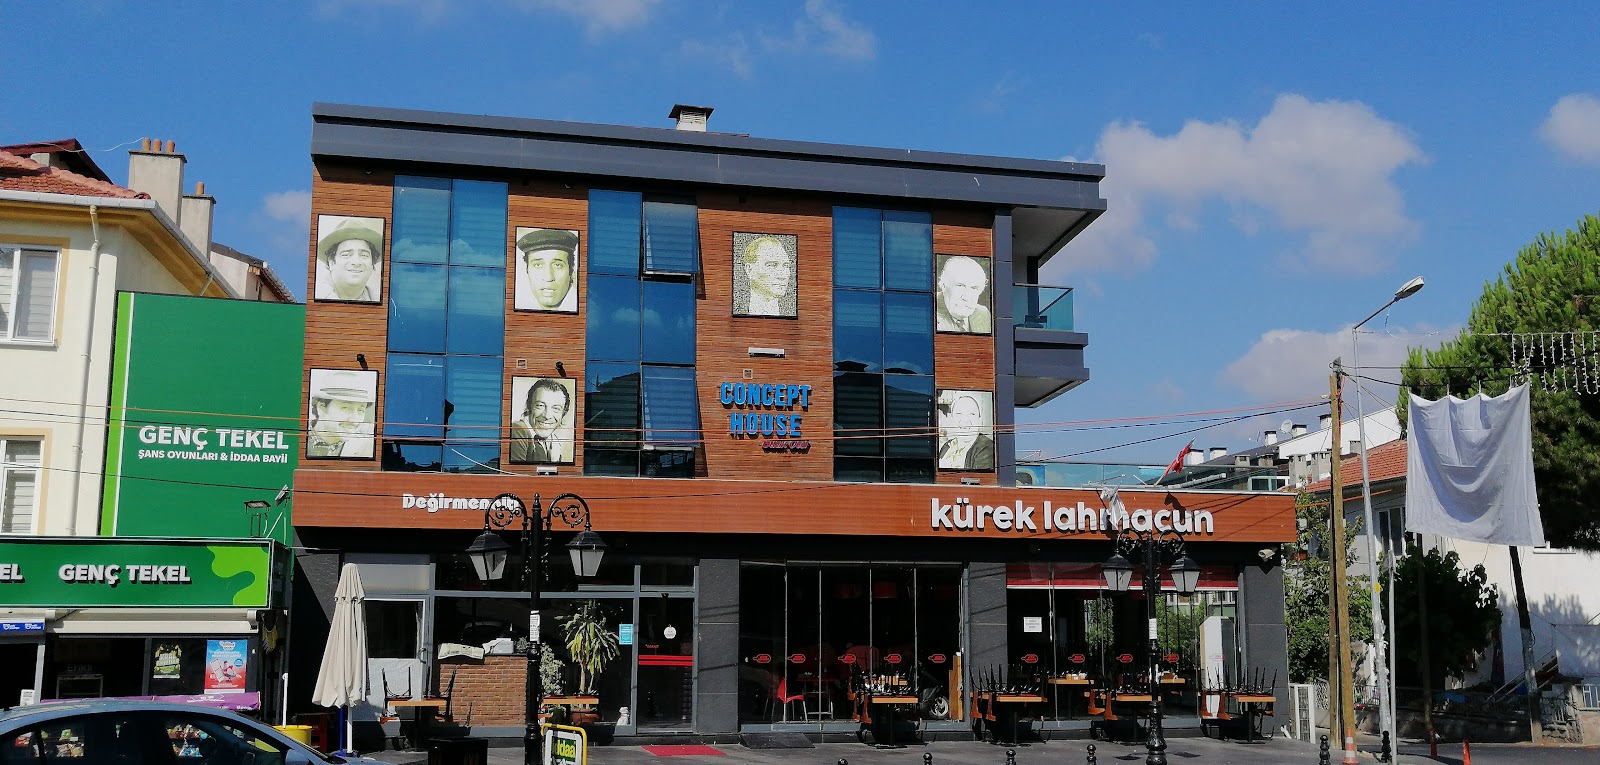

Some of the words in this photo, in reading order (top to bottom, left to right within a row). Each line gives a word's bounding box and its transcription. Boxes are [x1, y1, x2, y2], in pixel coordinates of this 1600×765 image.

[720, 382, 811, 407] CONCEPT
[730, 412, 802, 436] HOUSE
[139, 425, 208, 450] GENÇ
[216, 428, 289, 449] TEKEL
[138, 450, 165, 459] ŞANS
[167, 451, 218, 461] OYUNLARI
[220, 453, 228, 461] &
[230, 452, 260, 462] İDDAA
[931, 497, 1037, 531] kürek
[58, 564, 121, 585] GENÇ
[126, 565, 191, 582] TEKEL
